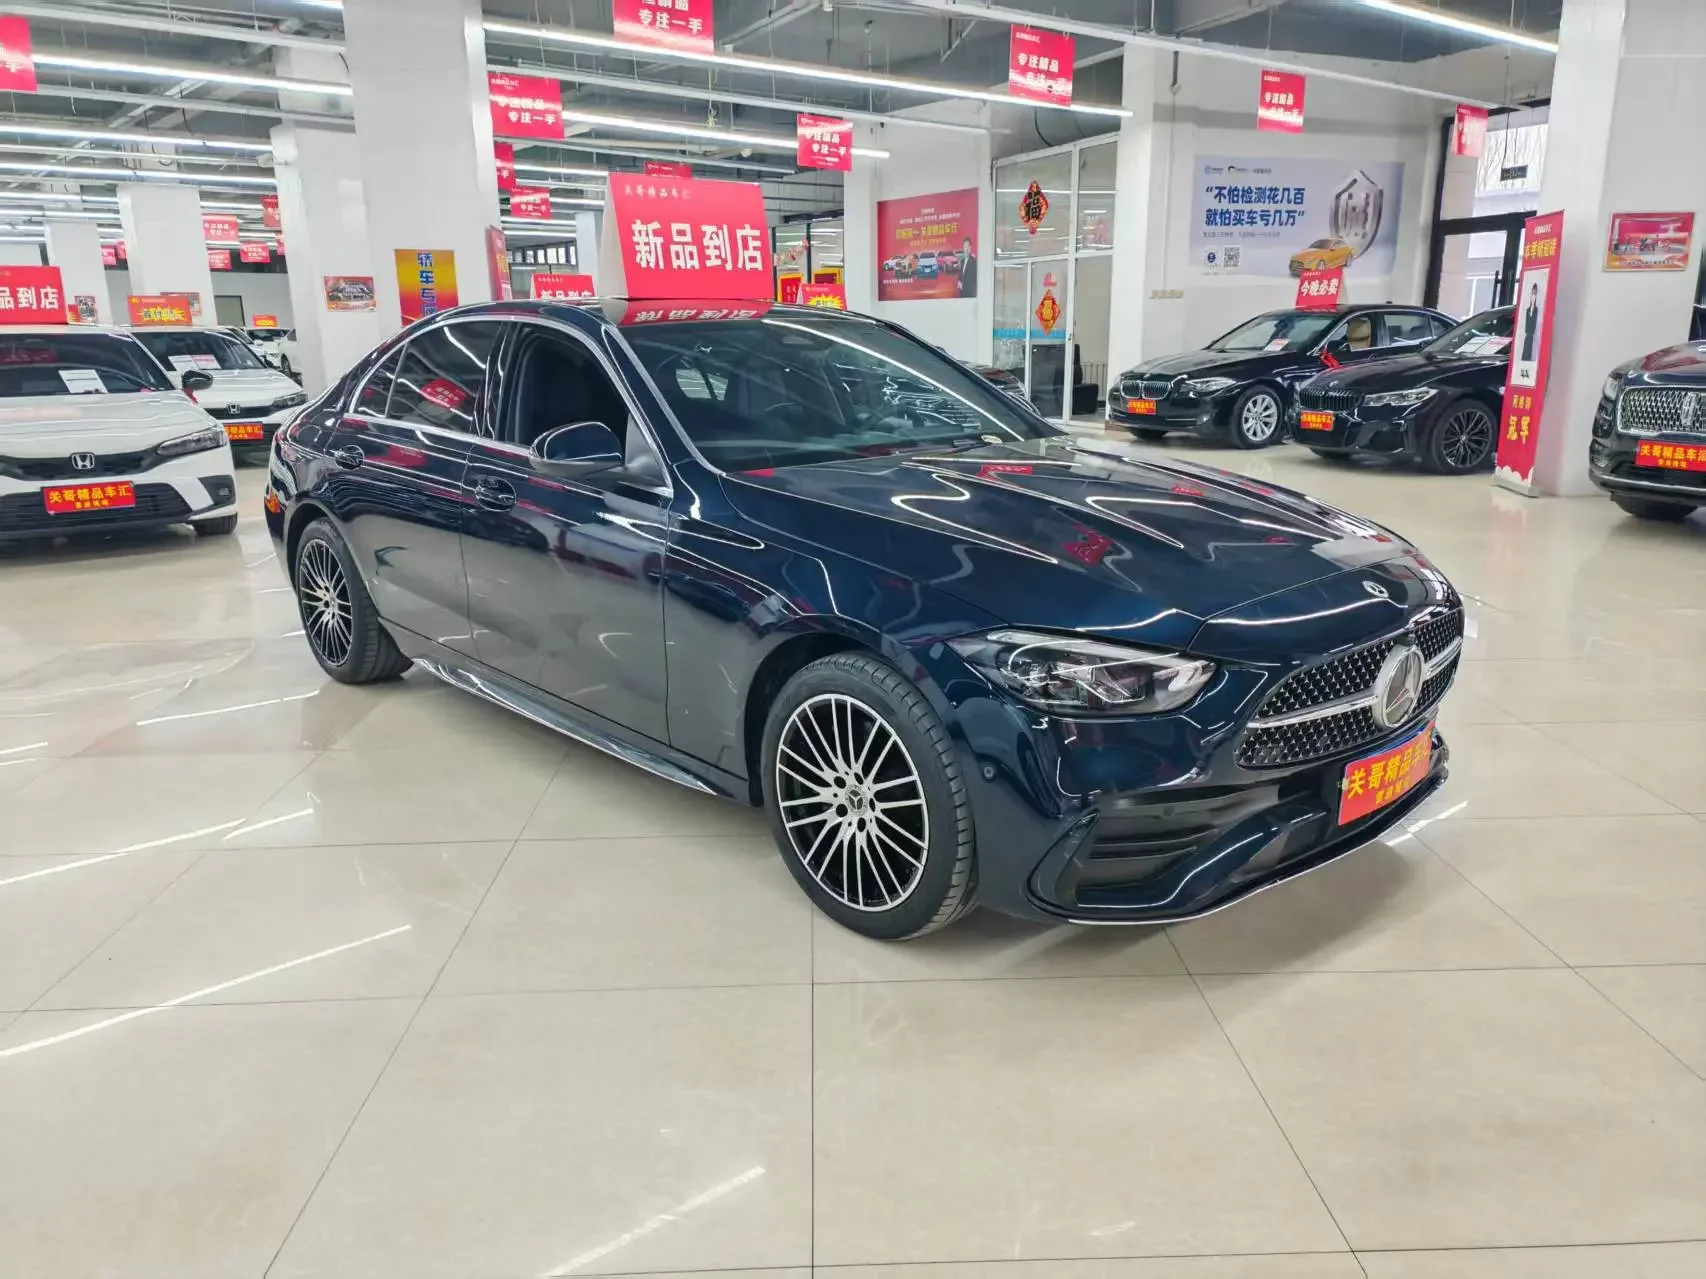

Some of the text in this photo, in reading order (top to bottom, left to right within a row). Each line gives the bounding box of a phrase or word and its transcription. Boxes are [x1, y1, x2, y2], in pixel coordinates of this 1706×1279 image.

[638, 9, 703, 37] 专注一手
[507, 111, 557, 126] 专注一手
[1205, 185, 1306, 205] “不怕检测花几百
[1204, 208, 1305, 227] 就怕买车亏几万”
[631, 219, 764, 271] 新品到店
[1300, 278, 1340, 297] 今晚必卖
[48, 485, 132, 504] 关哥精品车汇
